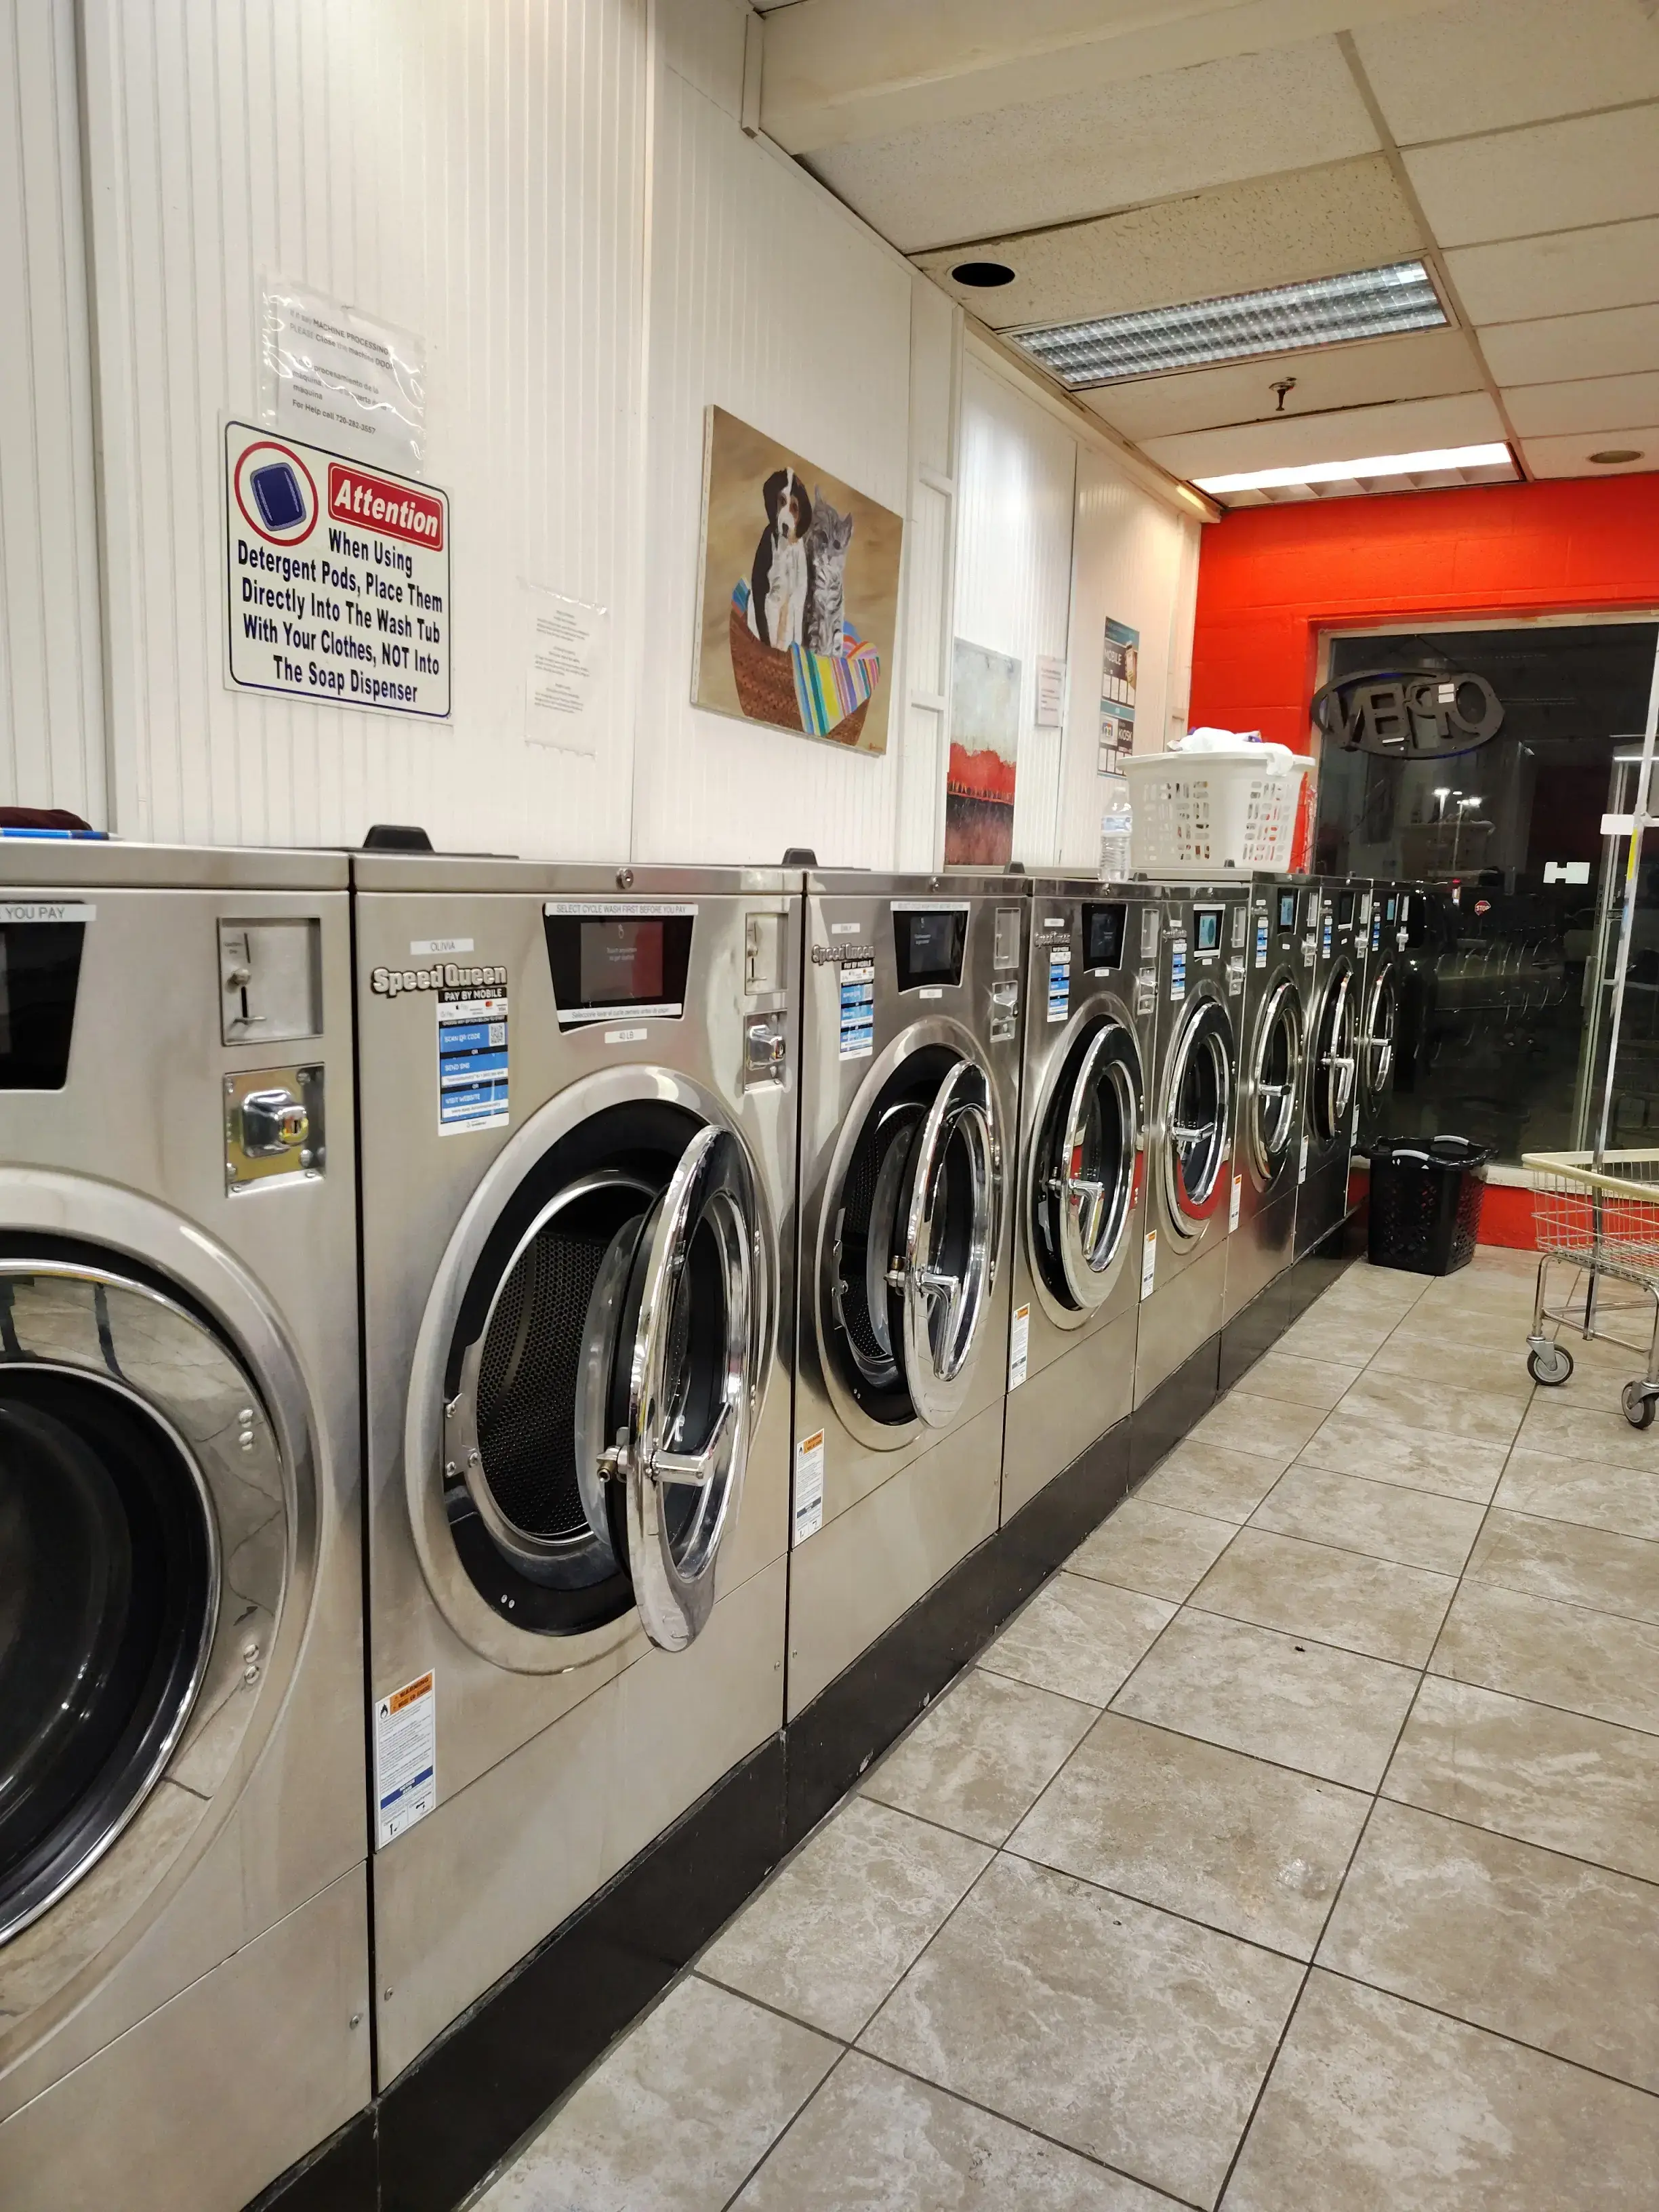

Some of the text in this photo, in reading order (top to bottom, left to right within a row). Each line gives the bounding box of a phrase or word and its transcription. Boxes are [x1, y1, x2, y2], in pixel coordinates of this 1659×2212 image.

[289, 323, 314, 339] PLEASE
[316, 334, 336, 346] Close
[349, 347, 374, 363] machine
[313, 319, 345, 338] MACHINE
[347, 332, 389, 355] PROCESSING
[364, 384, 371, 392] de
[373, 385, 379, 394] la
[292, 399, 376, 434] For Help call 720-282-3557
[334, 478, 438, 538] Attention
[329, 527, 413, 578] When Using
[237, 539, 443, 613] Detergent Pods, Place Them
[242, 577, 441, 644] Directly Into The Wash Tub
[243, 613, 440, 676] With Your Clothes, NOT Into
[1105, 649, 1122, 665] MOBILE
[273, 655, 418, 703] The Soap Dispenser
[1118, 728, 1132, 743] KIOSK
[5, 907, 65, 919] YOU PAY
[556, 905, 687, 914] SELECT CYCLE WASH FIRST BEFORE YOU PAY
[371, 963, 508, 999] Speed Queen
[445, 988, 501, 1001] PAY BY MOBILE
[459, 1093, 480, 1103] WEBSITE
